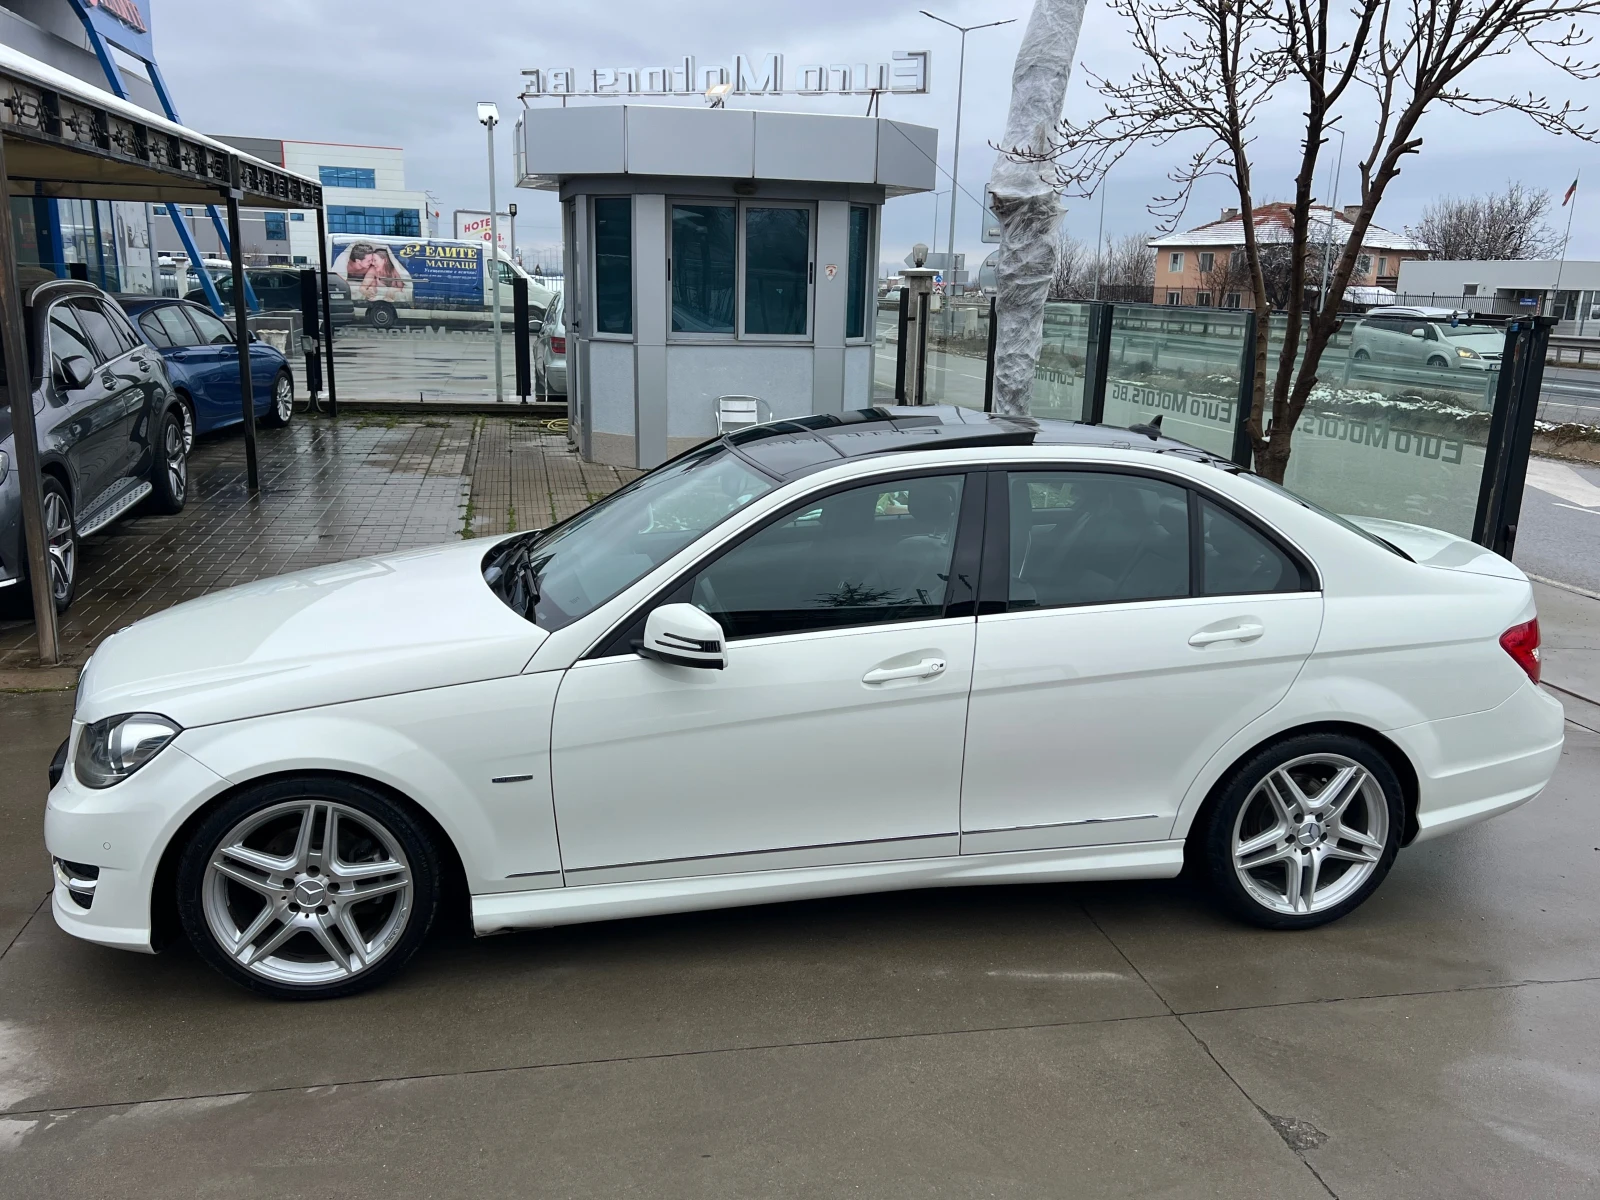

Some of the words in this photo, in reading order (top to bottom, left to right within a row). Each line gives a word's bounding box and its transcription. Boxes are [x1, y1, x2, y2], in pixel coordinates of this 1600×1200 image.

[464, 217, 491, 233] HOTE
[484, 232, 502, 241] Oi
[425, 245, 477, 259] ЕЛИТЕ
[425, 260, 477, 270] МАТРАЦИ
